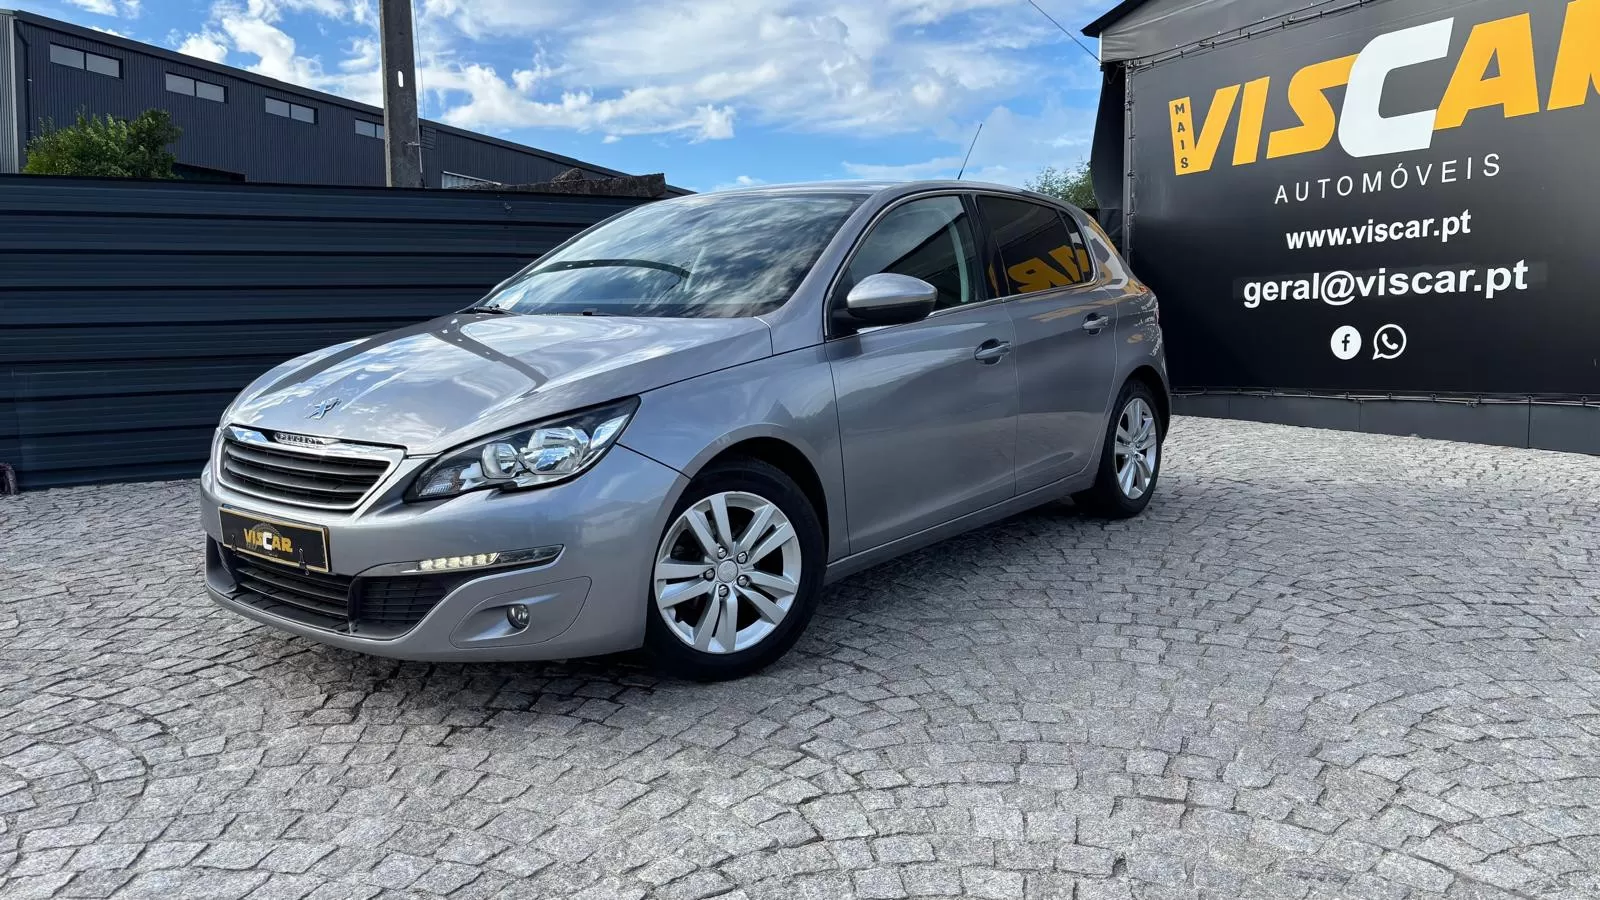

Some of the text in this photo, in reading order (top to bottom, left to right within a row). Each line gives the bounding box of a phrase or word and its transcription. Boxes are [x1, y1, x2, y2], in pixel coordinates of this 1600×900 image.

[1174, 103, 1188, 169] MAIS
[1275, 153, 1500, 205] AUTOMÓVEIS
[1286, 209, 1471, 250] www.viscar.pt
[1243, 259, 1529, 308] geral@viscar.pt
[243, 527, 293, 553] VISCAR
